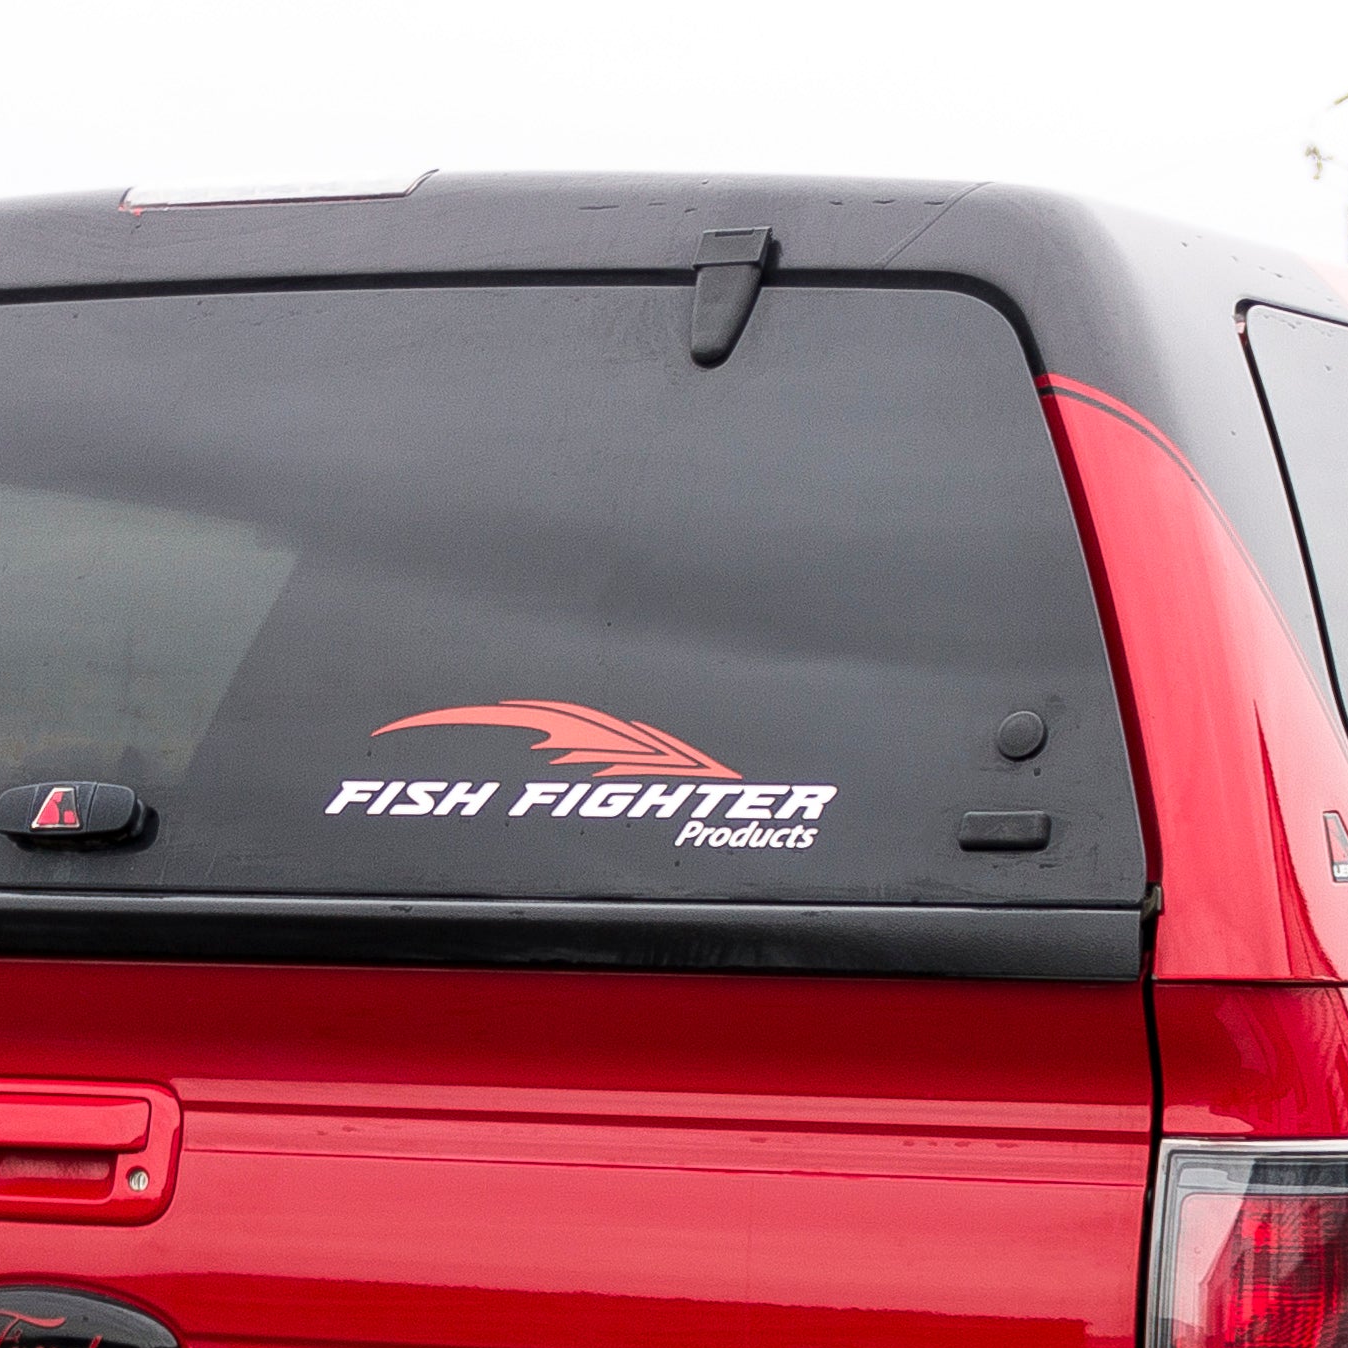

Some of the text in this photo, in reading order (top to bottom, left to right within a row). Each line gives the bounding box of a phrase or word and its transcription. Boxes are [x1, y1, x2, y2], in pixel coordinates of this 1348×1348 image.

[325, 781, 839, 821] FISH FIGHTER
[674, 820, 819, 850] Products
